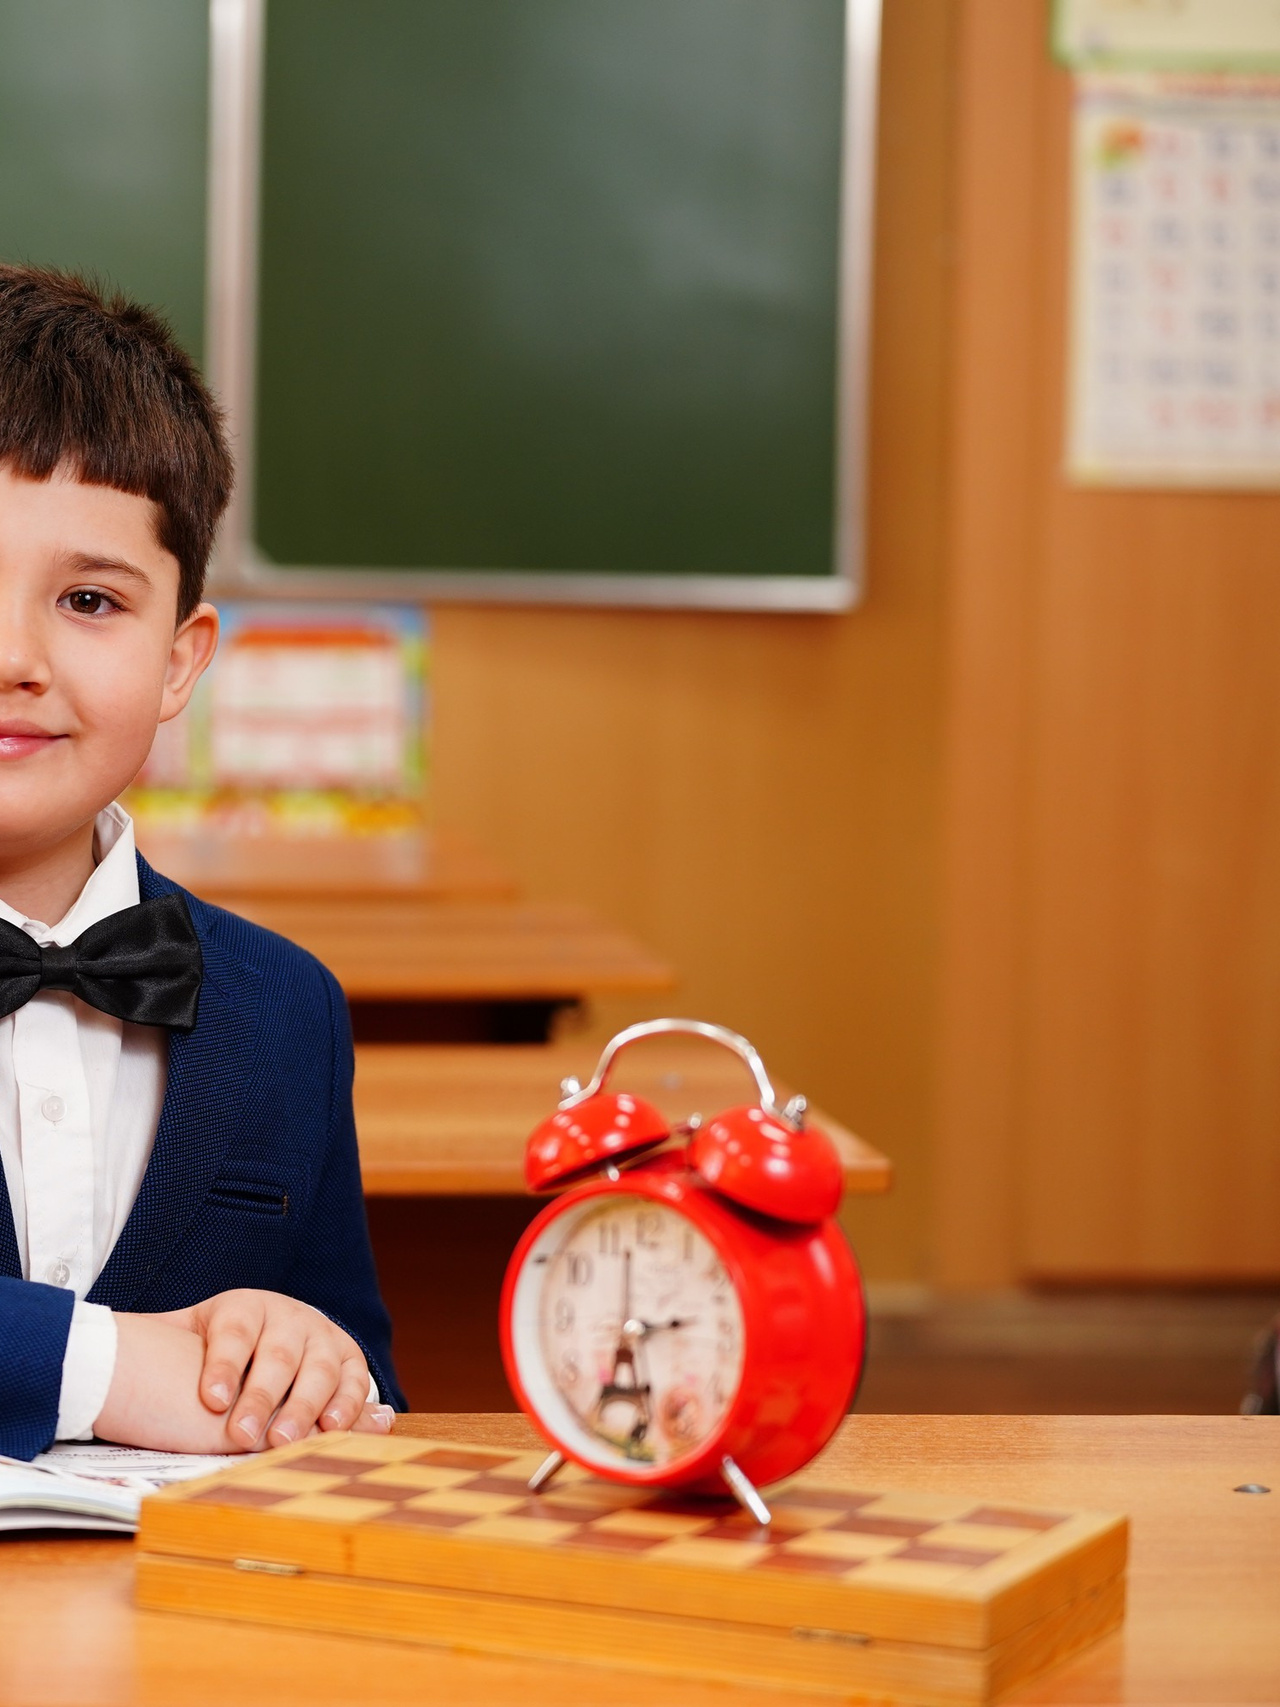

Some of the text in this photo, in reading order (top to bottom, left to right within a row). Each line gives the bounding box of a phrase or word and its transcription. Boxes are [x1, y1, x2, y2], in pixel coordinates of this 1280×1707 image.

[599, 1220, 620, 1257] 11
[635, 1211, 666, 1252] 12
[565, 1251, 595, 1288] 10
[554, 1296, 576, 1335] 9
